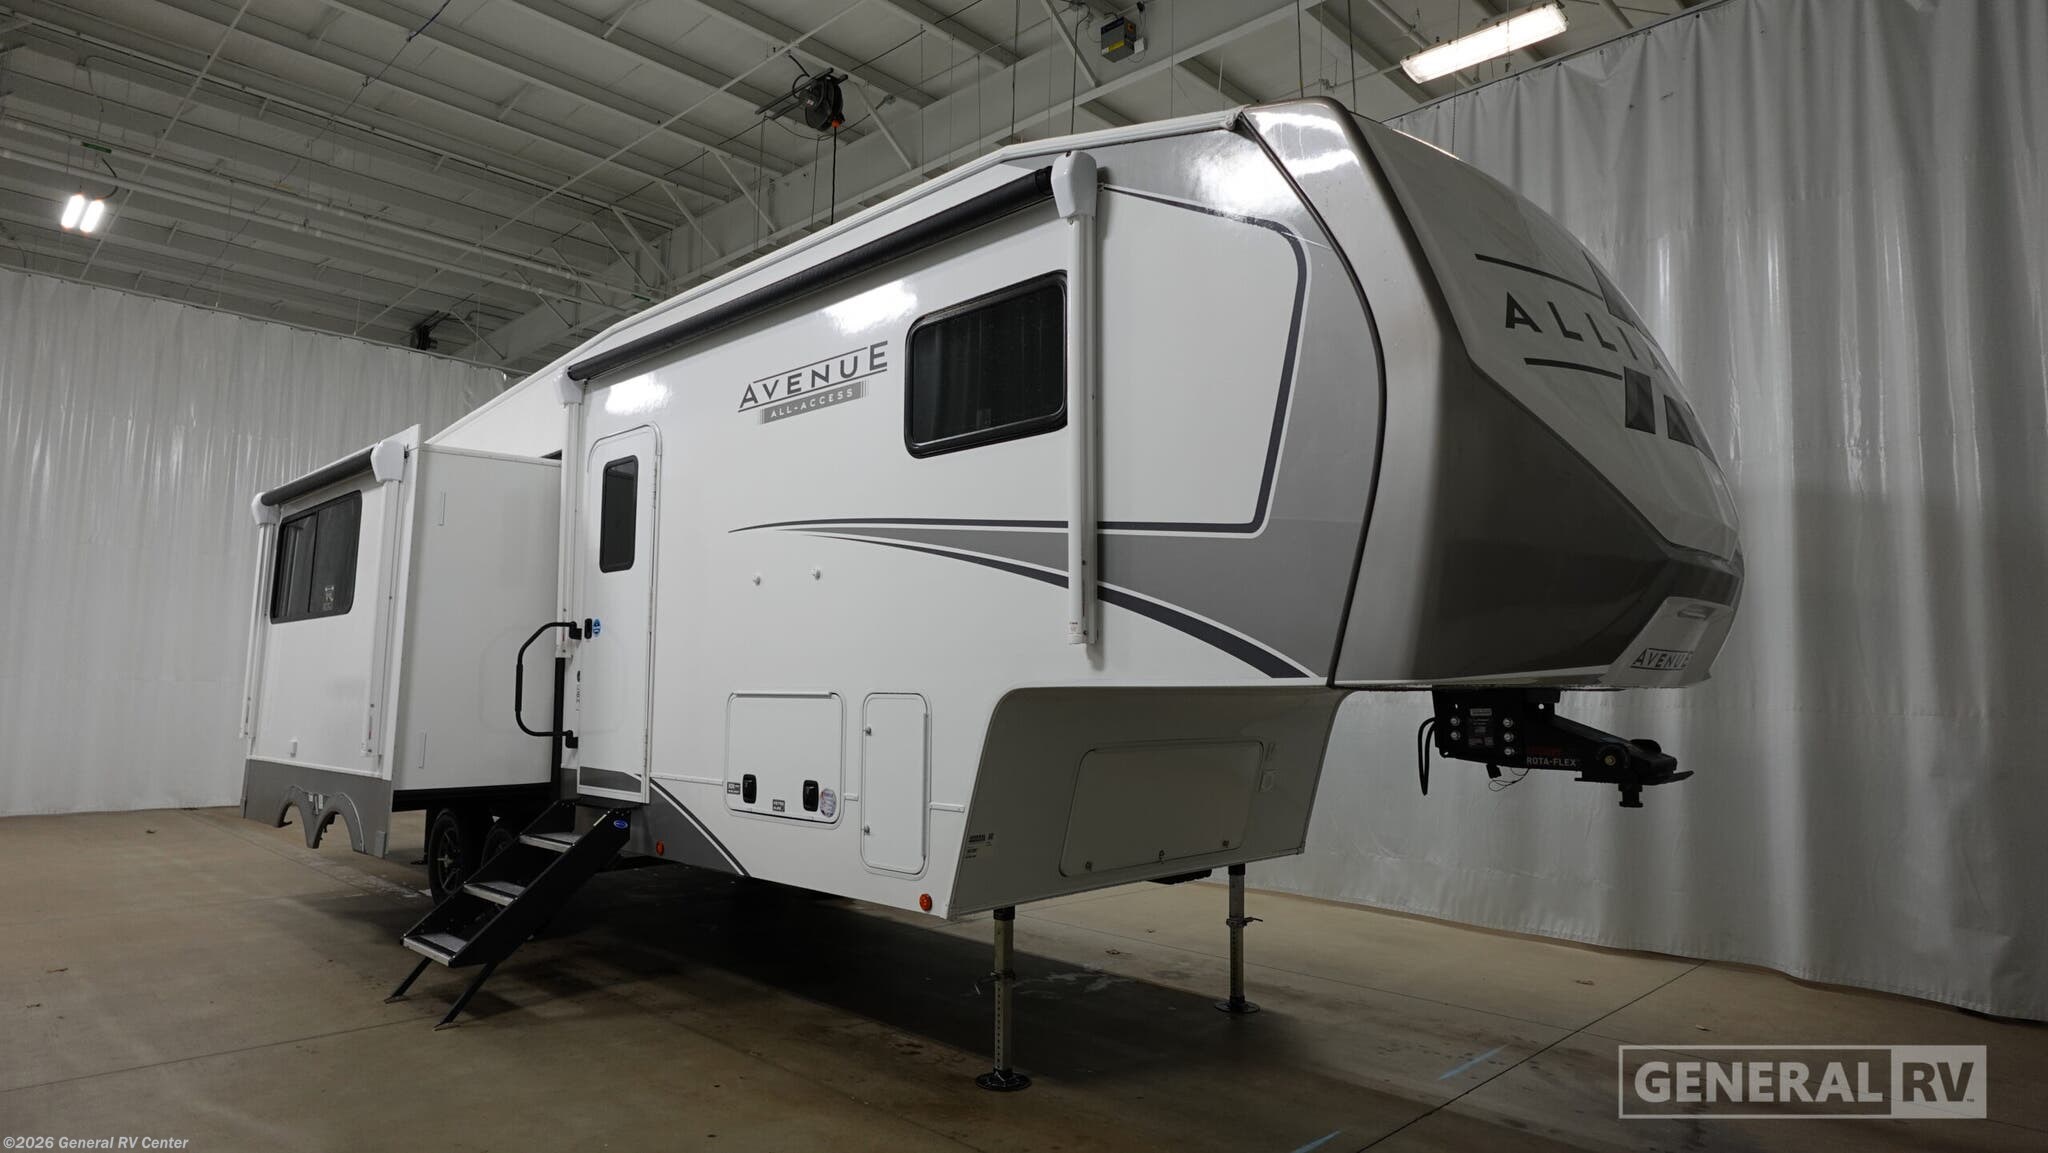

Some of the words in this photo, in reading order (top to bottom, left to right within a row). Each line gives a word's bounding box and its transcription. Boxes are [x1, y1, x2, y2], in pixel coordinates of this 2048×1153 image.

[740, 340, 888, 408] AVENUE
[770, 388, 853, 418] ALL-ACCESS
[1526, 756, 1577, 767] ROTA-FLEX
